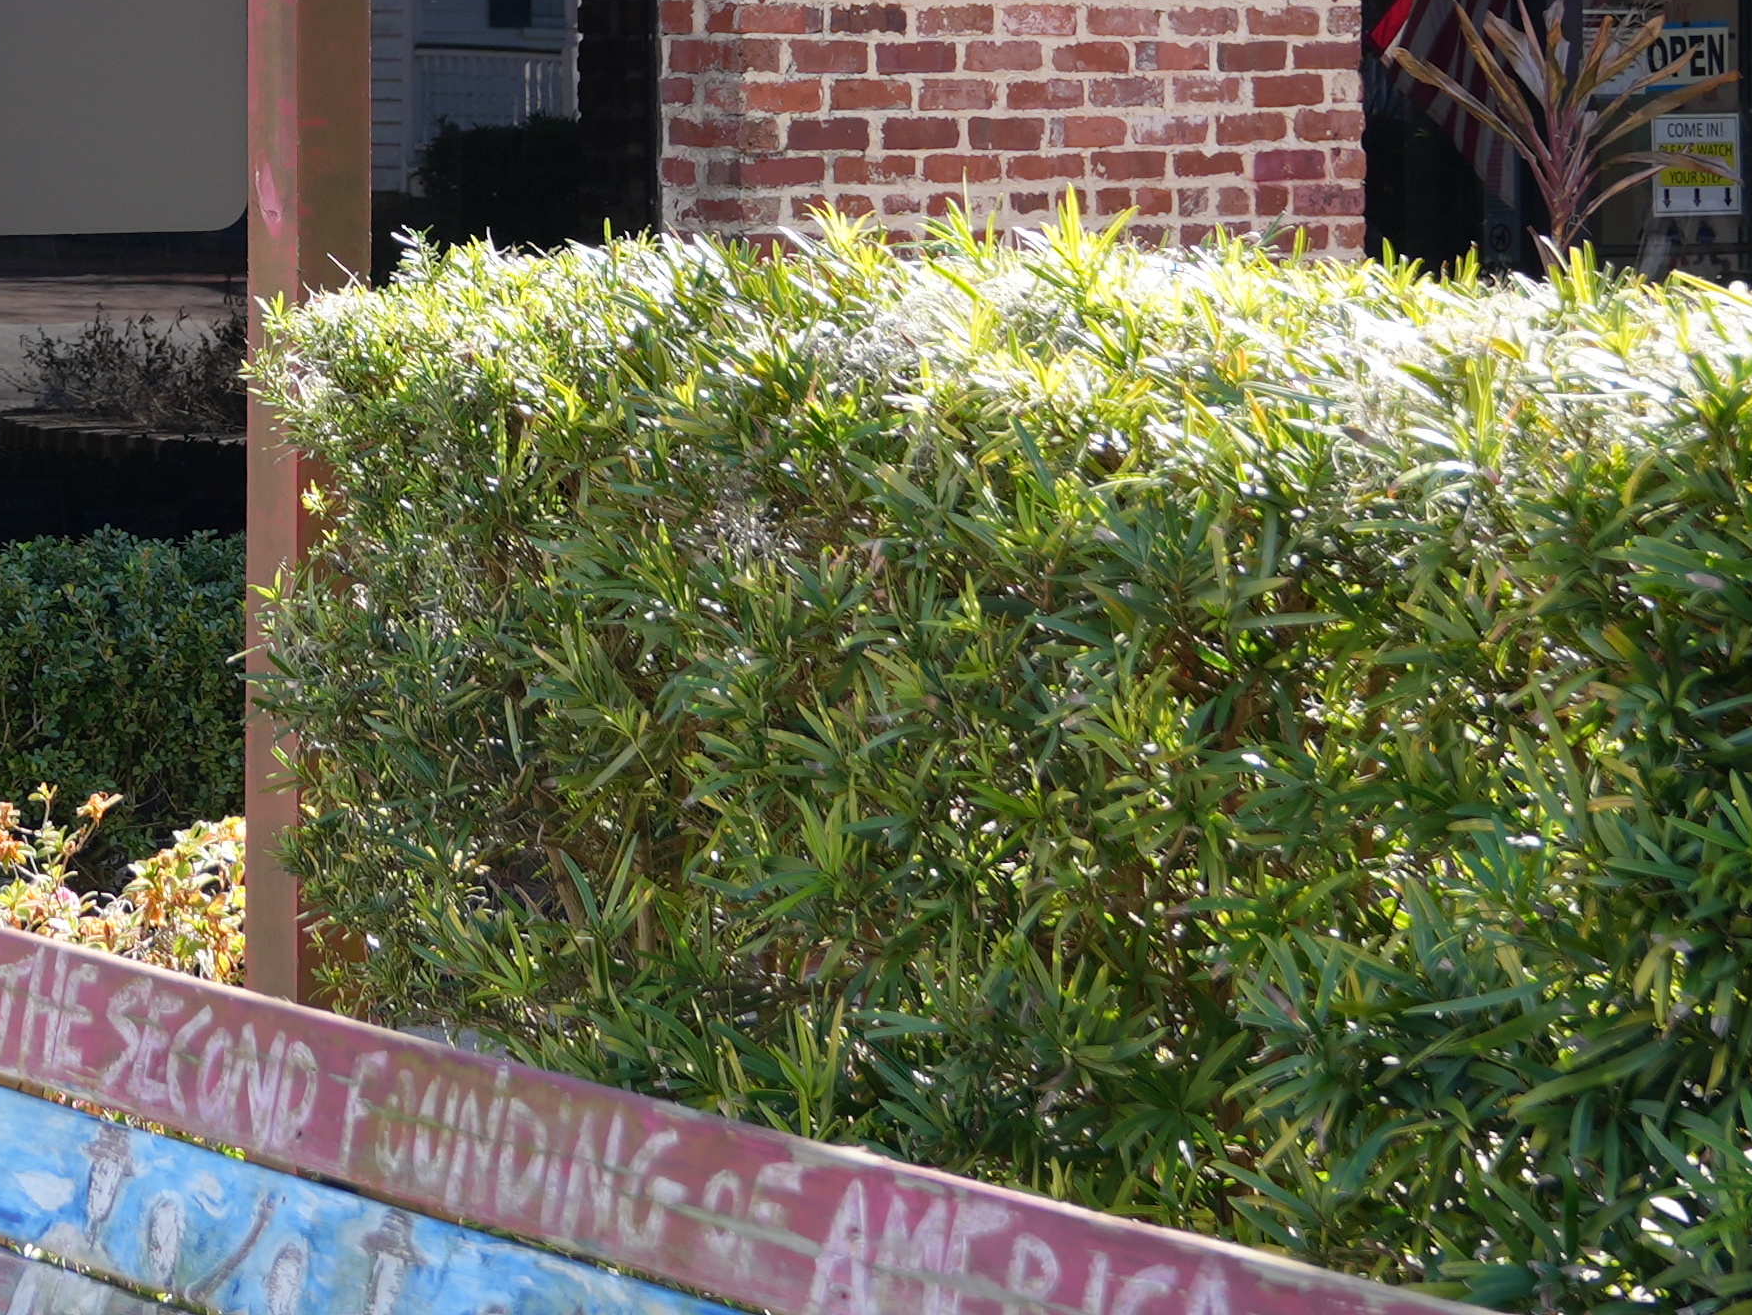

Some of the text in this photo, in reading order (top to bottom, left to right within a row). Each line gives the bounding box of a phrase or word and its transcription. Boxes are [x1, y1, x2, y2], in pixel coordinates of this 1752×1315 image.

[1648, 33, 1725, 77] OPEN
[1667, 122, 1724, 138] COME IN!
[1697, 144, 1733, 157] WATCH
[1669, 171, 1697, 184] YOUR
[104, 976, 318, 1157] SECOND
[340, 1050, 687, 1249] FOUNDING
